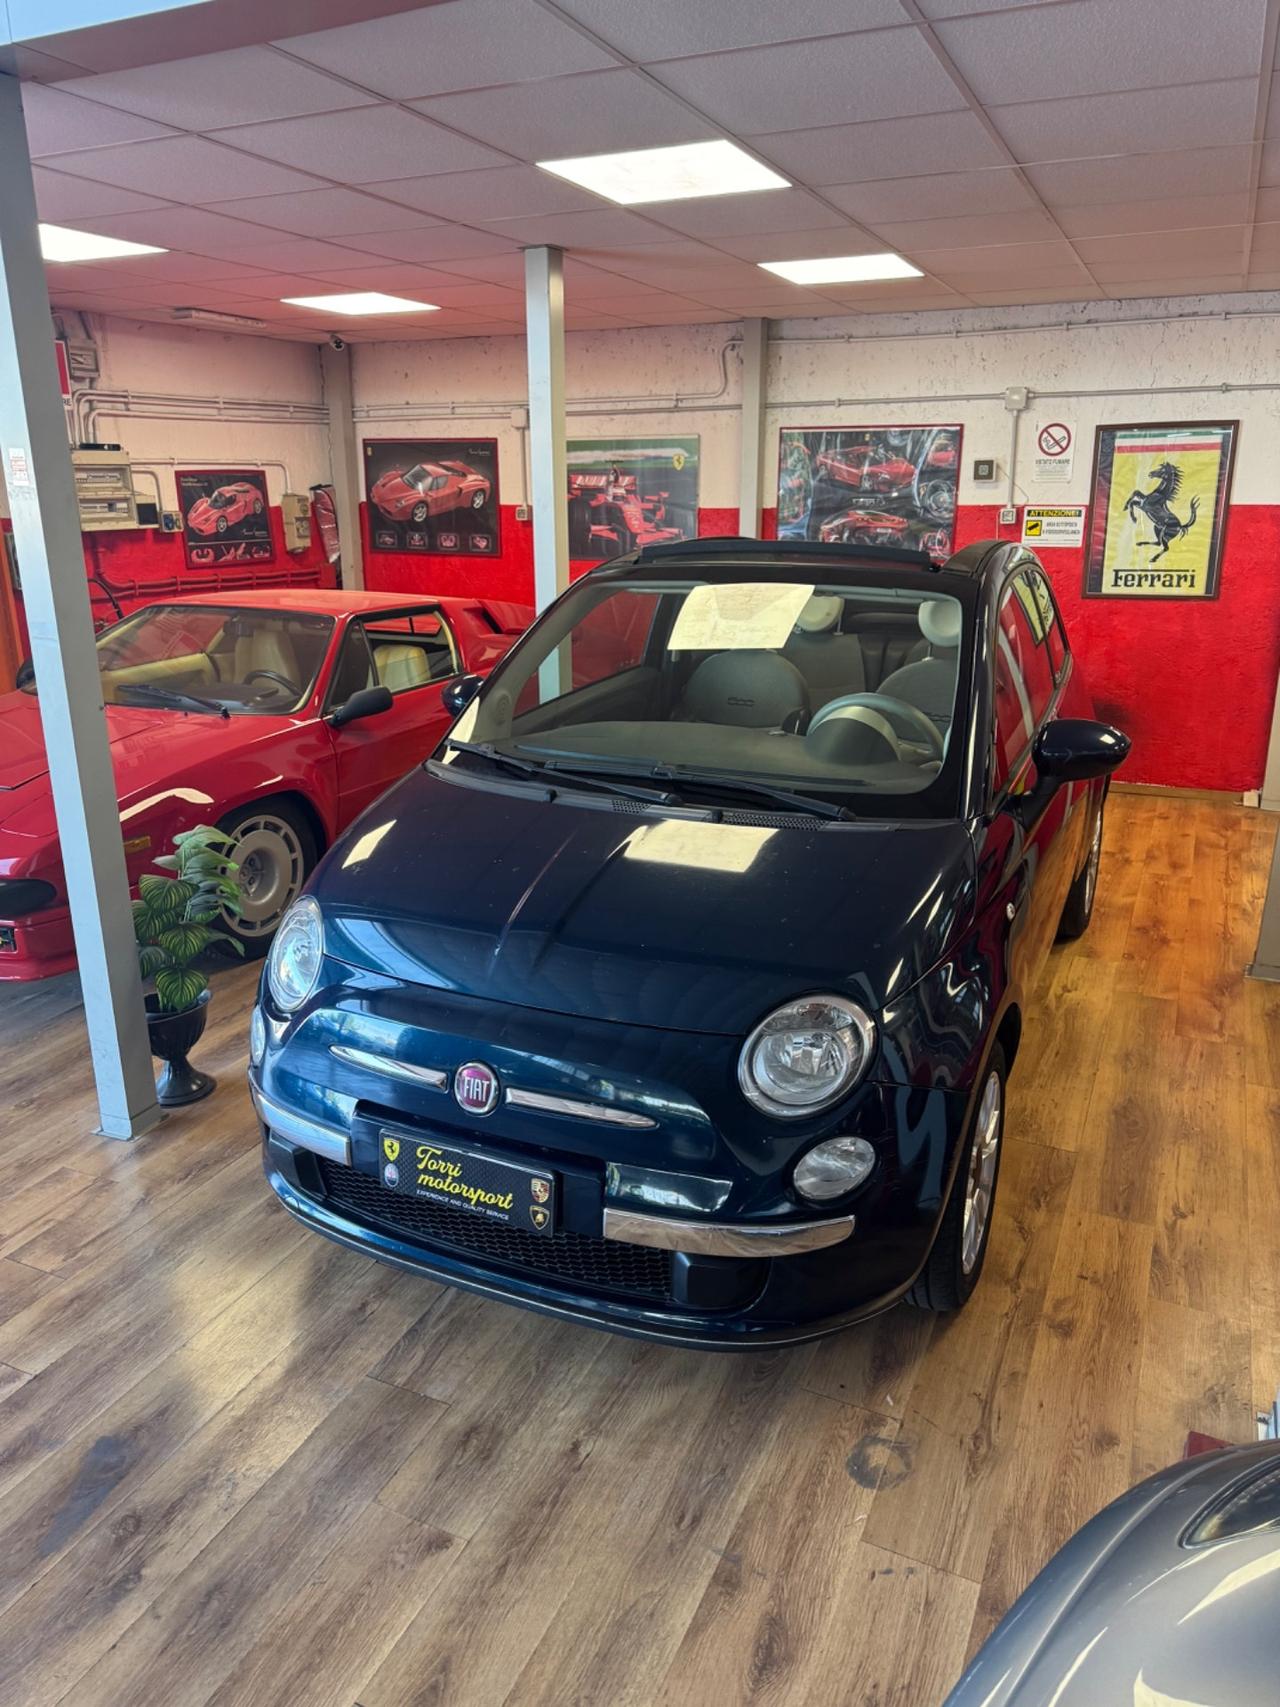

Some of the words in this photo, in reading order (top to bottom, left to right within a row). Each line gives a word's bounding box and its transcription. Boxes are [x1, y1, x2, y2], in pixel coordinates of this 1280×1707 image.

[1111, 569, 1196, 588] Ferrari
[464, 1077, 490, 1102] FIAT
[416, 1145, 463, 1177] Torri
[416, 1189, 449, 1203] EXPERIENCE
[450, 1199, 462, 1207] AND
[462, 1202, 486, 1214] QUALITY
[486, 1208, 510, 1221] SERVICE
[418, 1173, 513, 1210] motorsport
